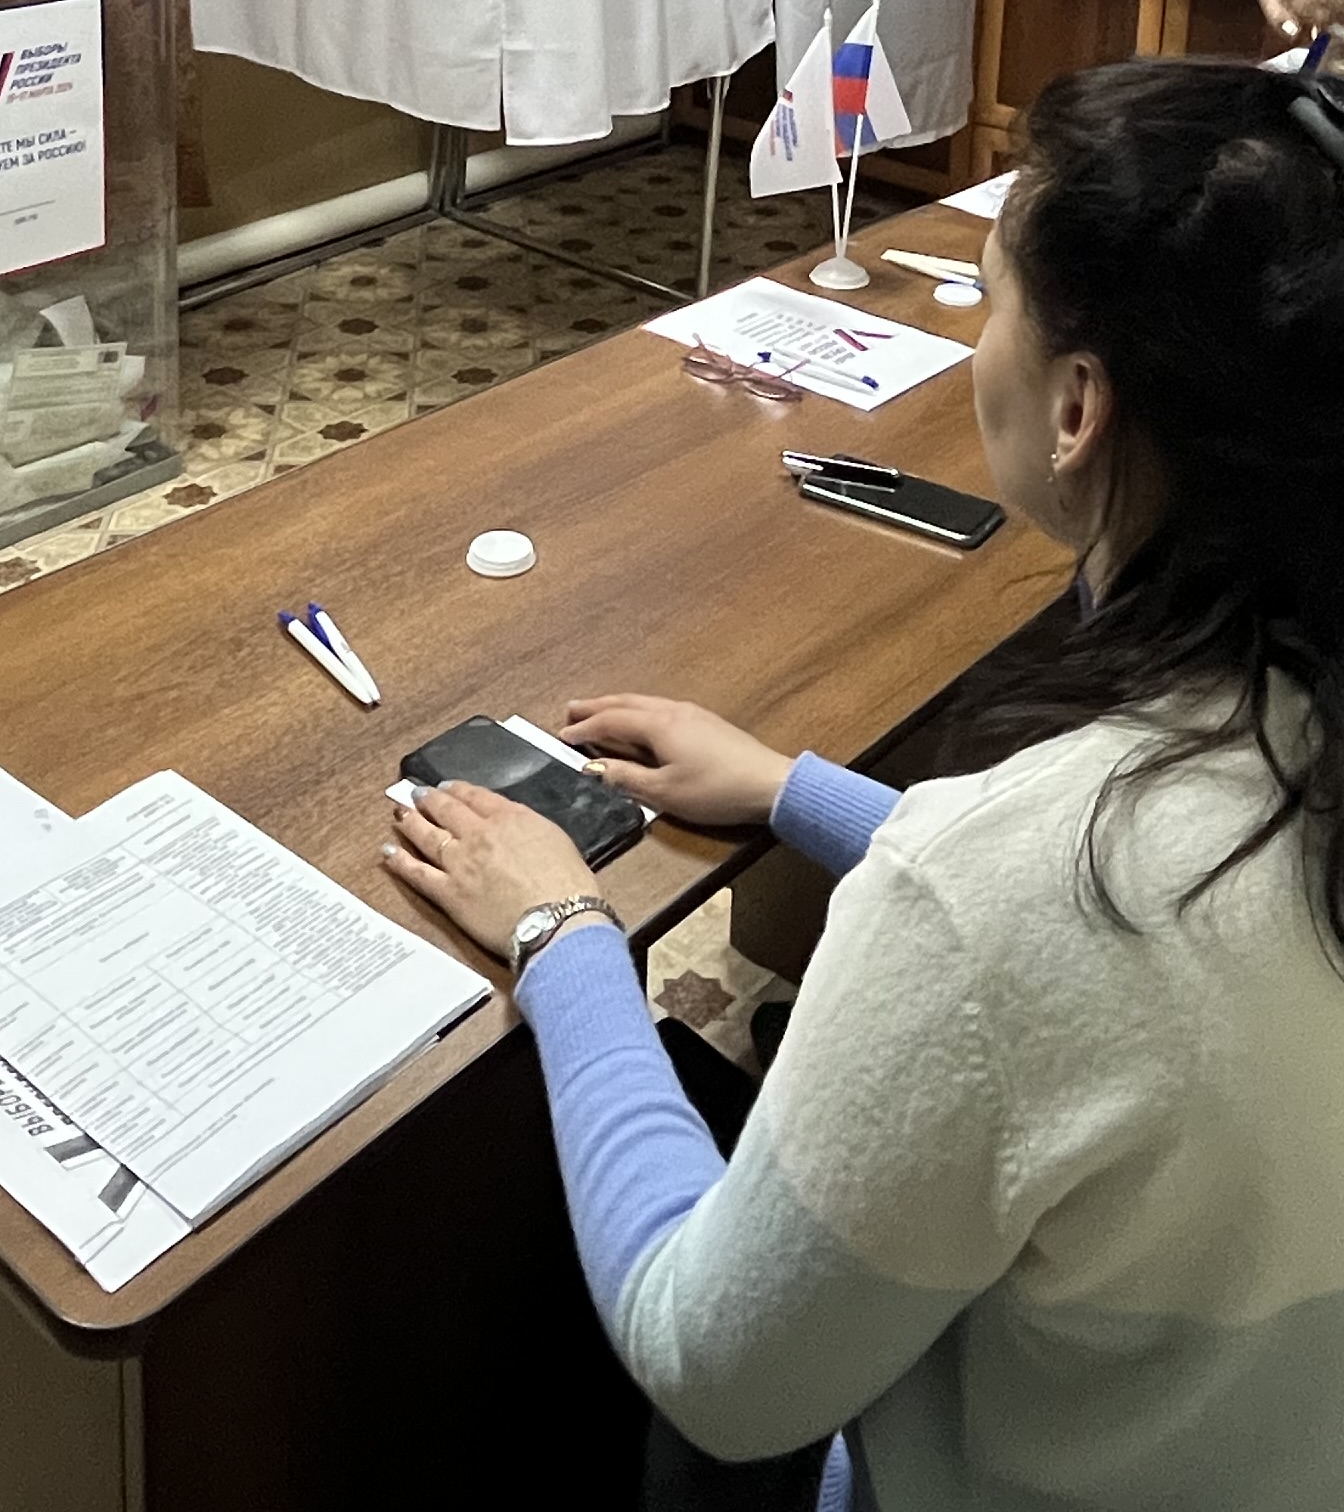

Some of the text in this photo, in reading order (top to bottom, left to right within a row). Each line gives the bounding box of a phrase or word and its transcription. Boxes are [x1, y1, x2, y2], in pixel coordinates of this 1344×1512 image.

[15, 135, 36, 151] МЫ
[37, 128, 67, 146] СИЛА
[21, 152, 36, 166] ЗА
